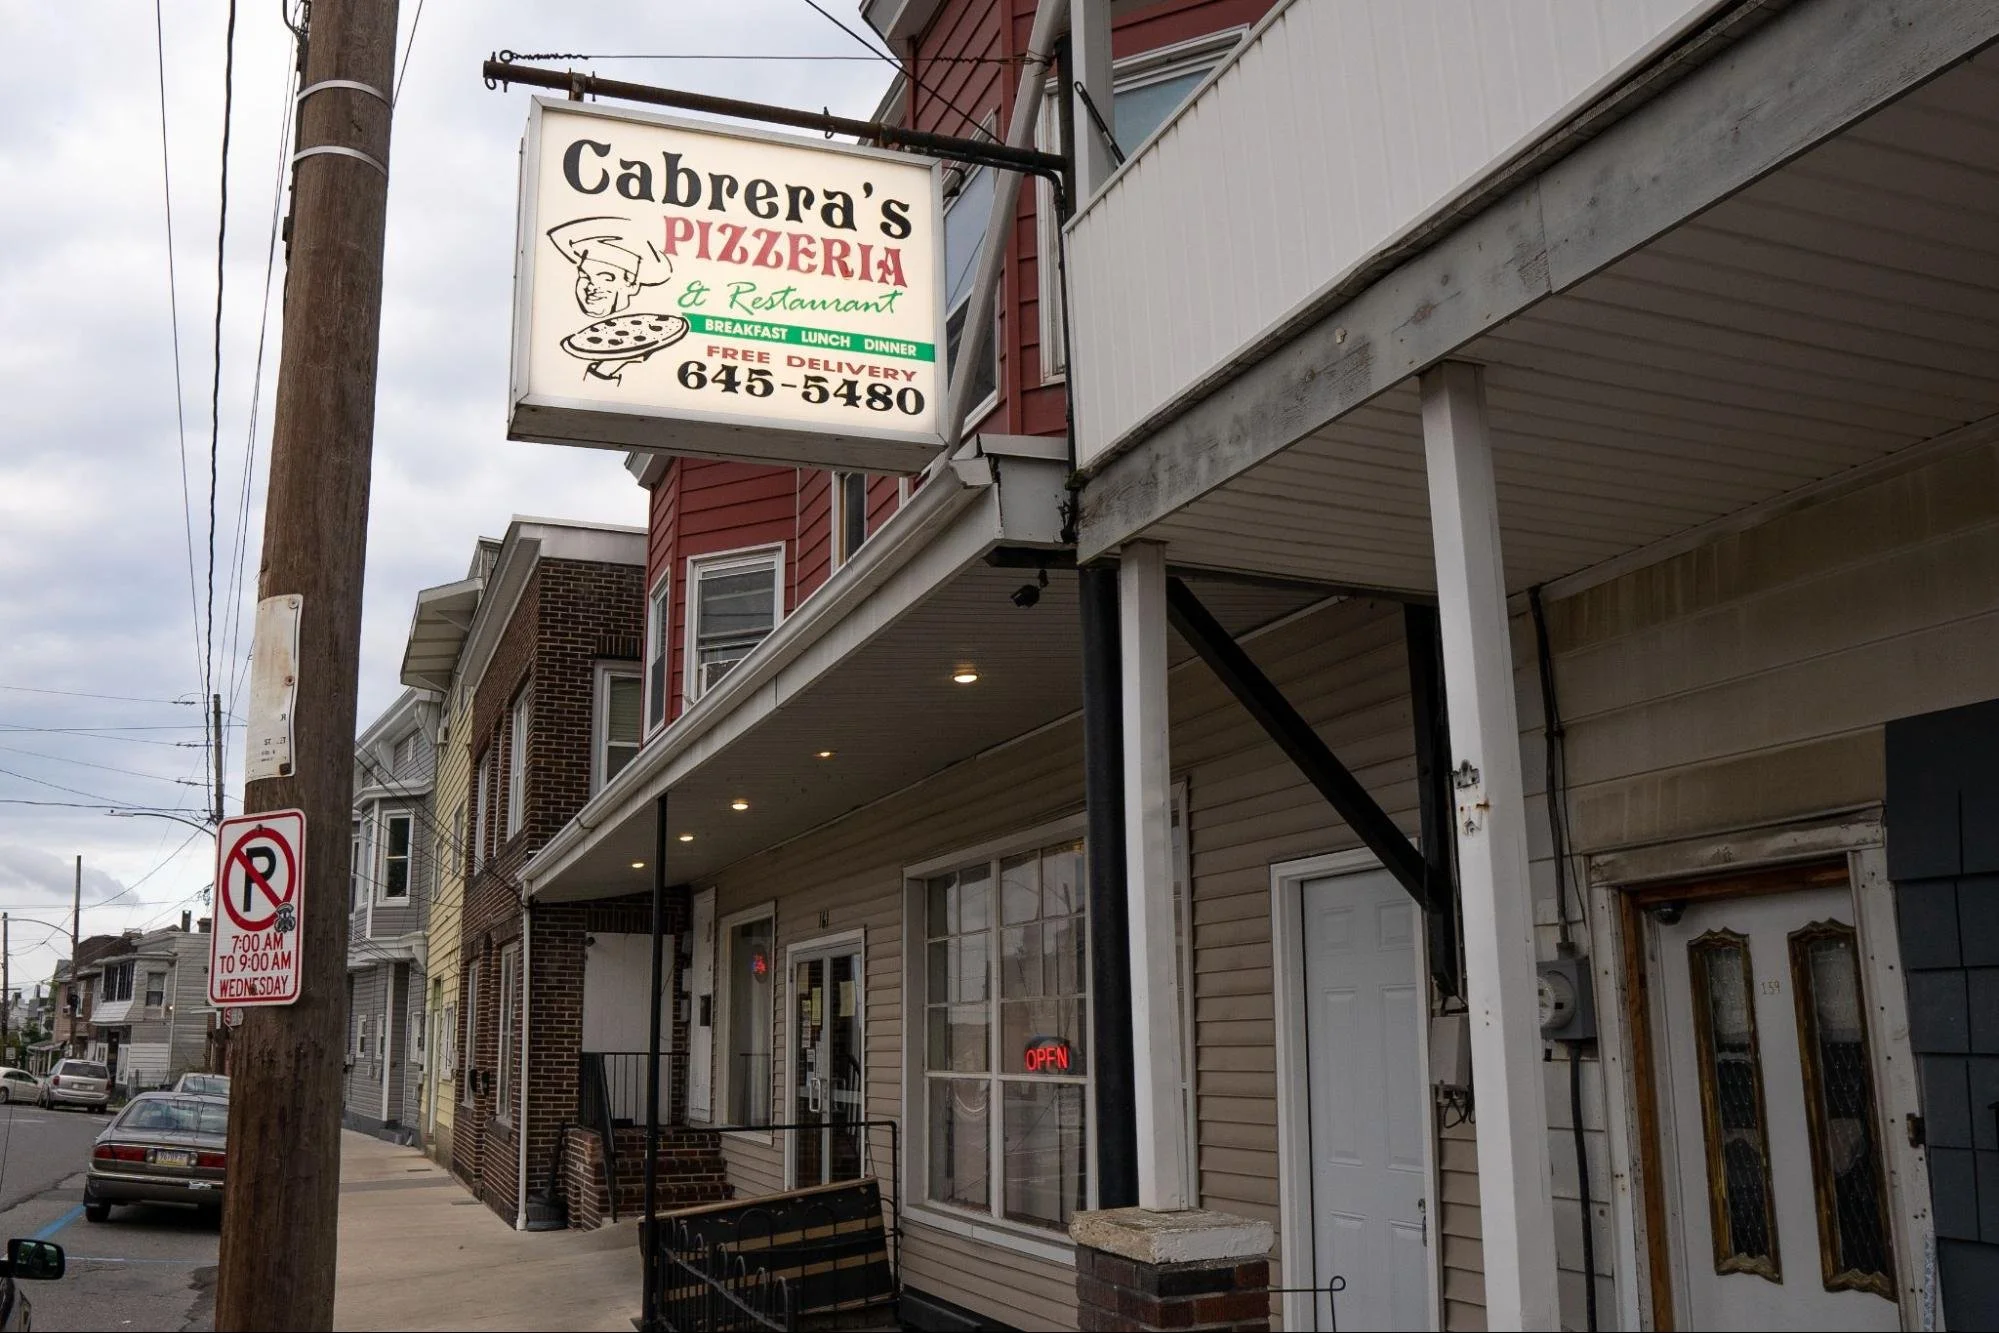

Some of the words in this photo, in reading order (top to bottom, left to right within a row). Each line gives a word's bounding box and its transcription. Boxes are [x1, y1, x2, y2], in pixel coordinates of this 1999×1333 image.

[562, 138, 912, 240] Cabrera's
[663, 215, 908, 288] PIZZERIA
[727, 282, 904, 315] Restaurant
[705, 319, 788, 341] BREAKFAST
[801, 330, 850, 348] LUNCH
[864, 338, 917, 357] DINNER
[706, 345, 770, 364] FREE
[786, 354, 917, 382] DELIVERY
[677, 360, 925, 416] 645-5480
[231, 934, 260, 954] 7:00
[262, 932, 284, 952] AM
[219, 955, 235, 974] TO
[240, 953, 269, 972] 9:00
[271, 950, 292, 971] AM
[219, 975, 289, 998] WEDNESDAY
